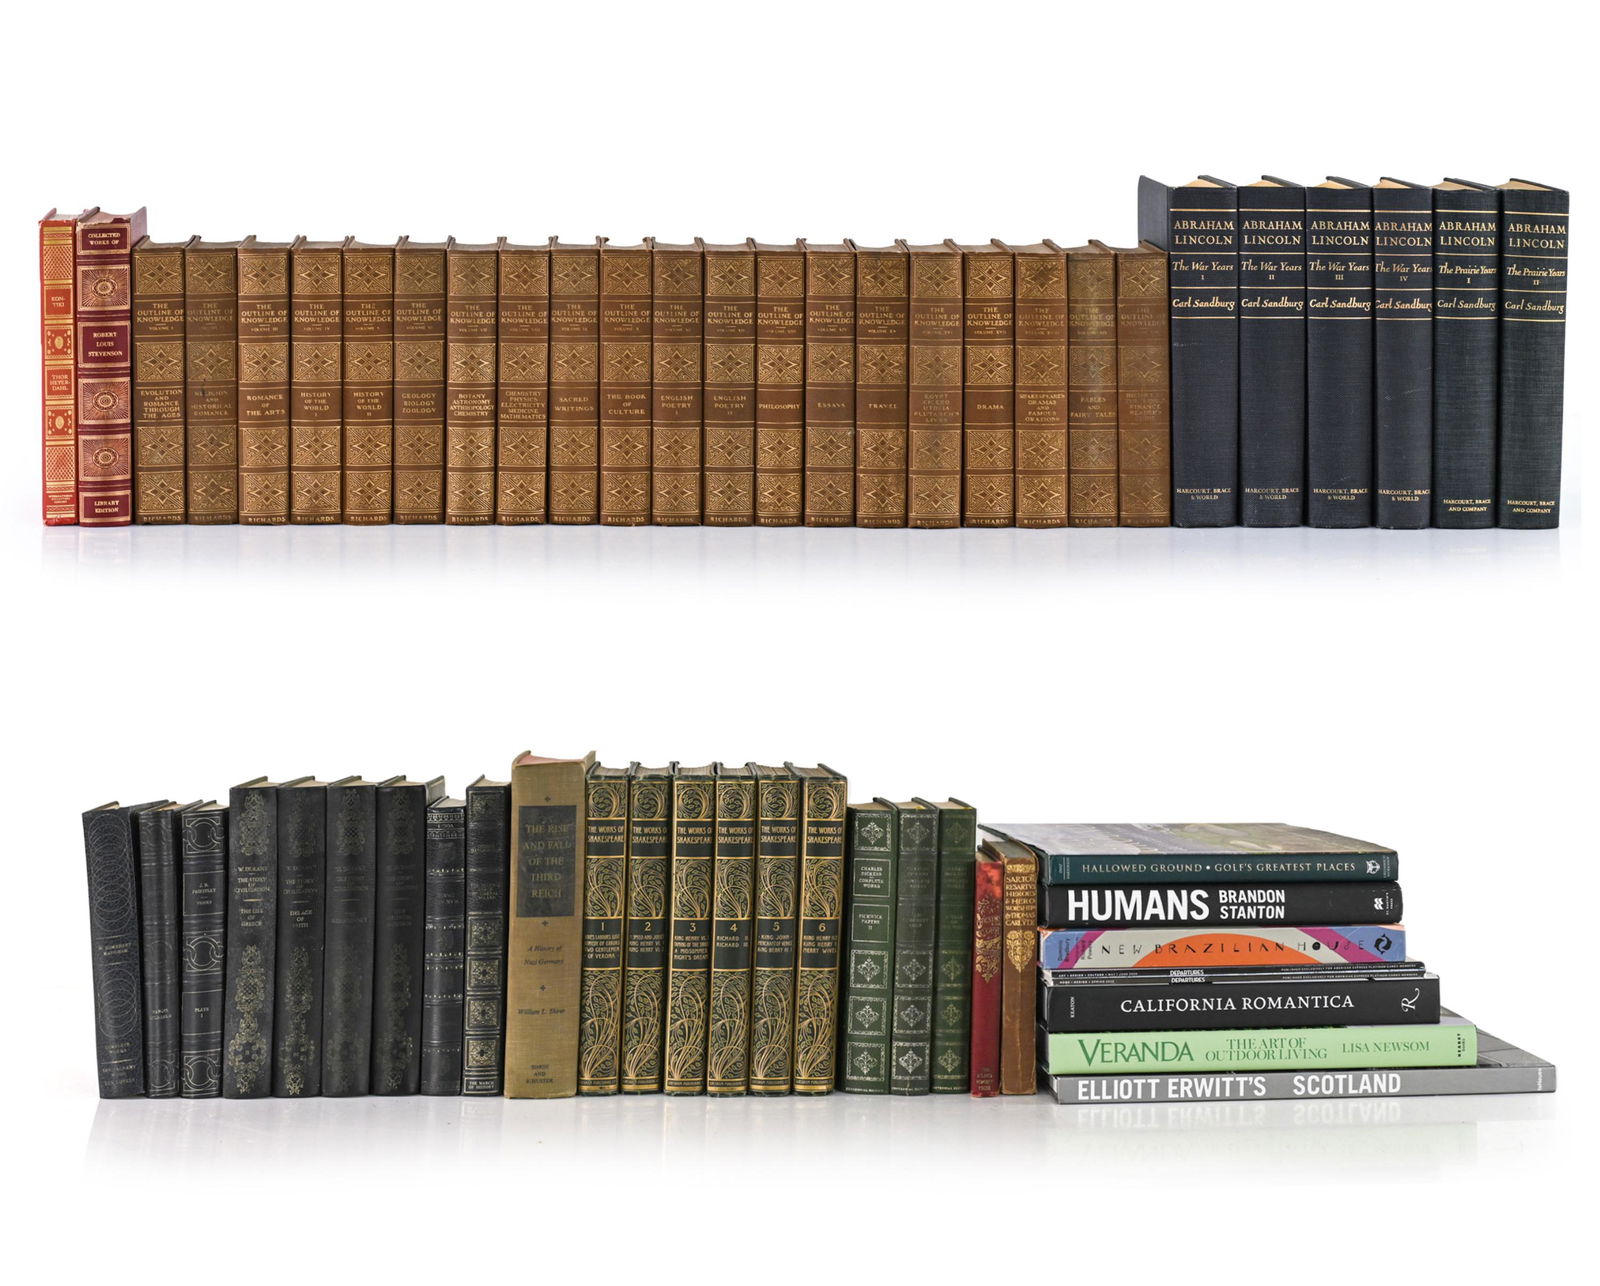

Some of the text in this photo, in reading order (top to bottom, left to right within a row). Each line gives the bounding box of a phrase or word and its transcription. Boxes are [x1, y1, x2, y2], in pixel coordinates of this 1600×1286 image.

[1174, 220, 1234, 231] ABRAHAM
[1243, 220, 1302, 231] ABRAHAM
[1311, 220, 1371, 231] ABRAHAM
[1375, 222, 1432, 232] ABRAHAM
[1440, 222, 1496, 232] ABRAHAM
[1508, 224, 1566, 234] ABRAHAM
[1175, 235, 1232, 245] LINCOLN
[1244, 235, 1301, 245] LINCOLN
[1312, 235, 1369, 246] LINCOLN
[1376, 237, 1432, 246] LINCOLN
[1440, 236, 1495, 246] LINCOLN
[1509, 238, 1564, 248] LINCOLN
[1172, 259, 1234, 271] The War Years
[1241, 259, 1302, 271] The War Years
[1309, 259, 1370, 272] The War Years
[1376, 260, 1390, 272] The
[1392, 264, 1410, 272] War
[1439, 261, 1496, 274] The Prairie Years
[1507, 266, 1566, 277] The Prairie Years
[1172, 298, 1236, 310] Carl Sandburg
[1241, 298, 1304, 311] Carl Sandburg
[1310, 298, 1371, 311] Carl Sandburg
[1394, 298, 1432, 312] Sandburg
[1437, 298, 1496, 312] Carl Sandburg
[1504, 299, 1564, 314] Carl Sandburg
[526, 824, 568, 833] THE RISE
[524, 840, 571, 850] AND FALL
[528, 857, 564, 866] OF THE
[1082, 862, 1356, 872] HALLOWED GROUND GOLF'S GREATEST PLACES
[530, 872, 561, 882] THIRD
[531, 888, 562, 898] REICH
[1218, 890, 1286, 904] BRANDON
[1068, 890, 1210, 920] HUMANS
[1220, 905, 1285, 920] STANTON
[601, 922, 604, 931] 1
[644, 922, 651, 931] 2
[690, 922, 696, 932] 3
[730, 923, 737, 932] 4
[773, 922, 780, 932] 5
[818, 922, 826, 932] 6
[1102, 944, 1142, 955] NEW
[1154, 942, 1284, 954] BRAZILIAN
[1298, 940, 1364, 952] HOUSE
[1120, 996, 1354, 1012] CALIFORNIA ROMANTICA
[1226, 1037, 1306, 1050] THE ART OF
[1343, 1041, 1430, 1053] LISA NEWSOM
[1078, 1040, 1194, 1067] VERANDA
[1206, 1048, 1328, 1062] OUTDOOR LIVING
[1078, 1073, 1401, 1100] ELLIOTT ERWITT'S SCOTLAND
